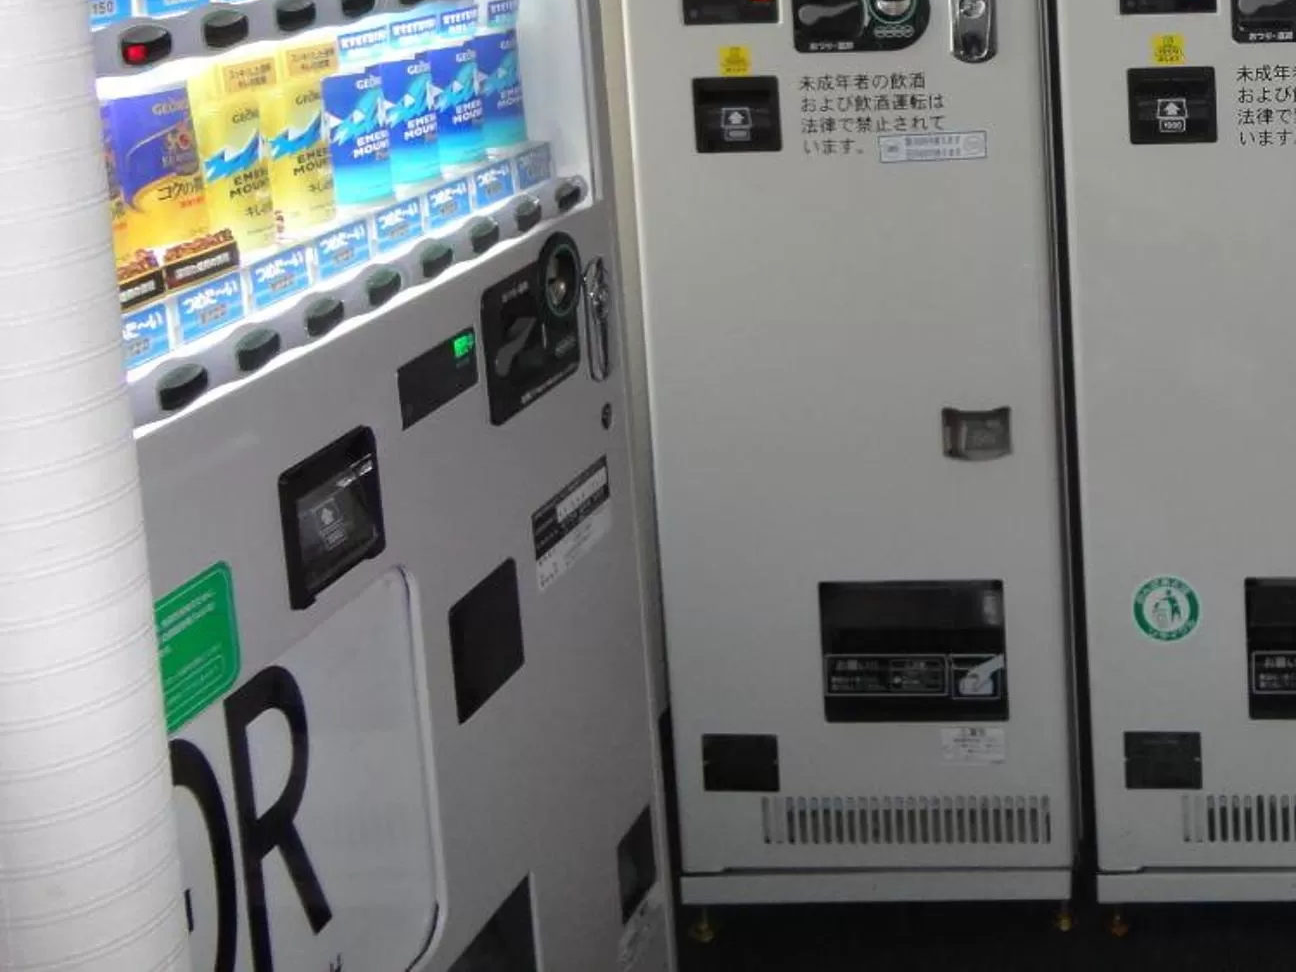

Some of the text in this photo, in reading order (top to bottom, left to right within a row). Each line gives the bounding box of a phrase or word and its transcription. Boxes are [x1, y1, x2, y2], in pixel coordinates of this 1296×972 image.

[91, 0, 114, 14] 150
[800, 72, 926, 90] 未成年者の飲酒
[801, 94, 945, 112] および飲酒運転は
[802, 115, 946, 133] 法律で禁止されて
[804, 140, 864, 155] います。
